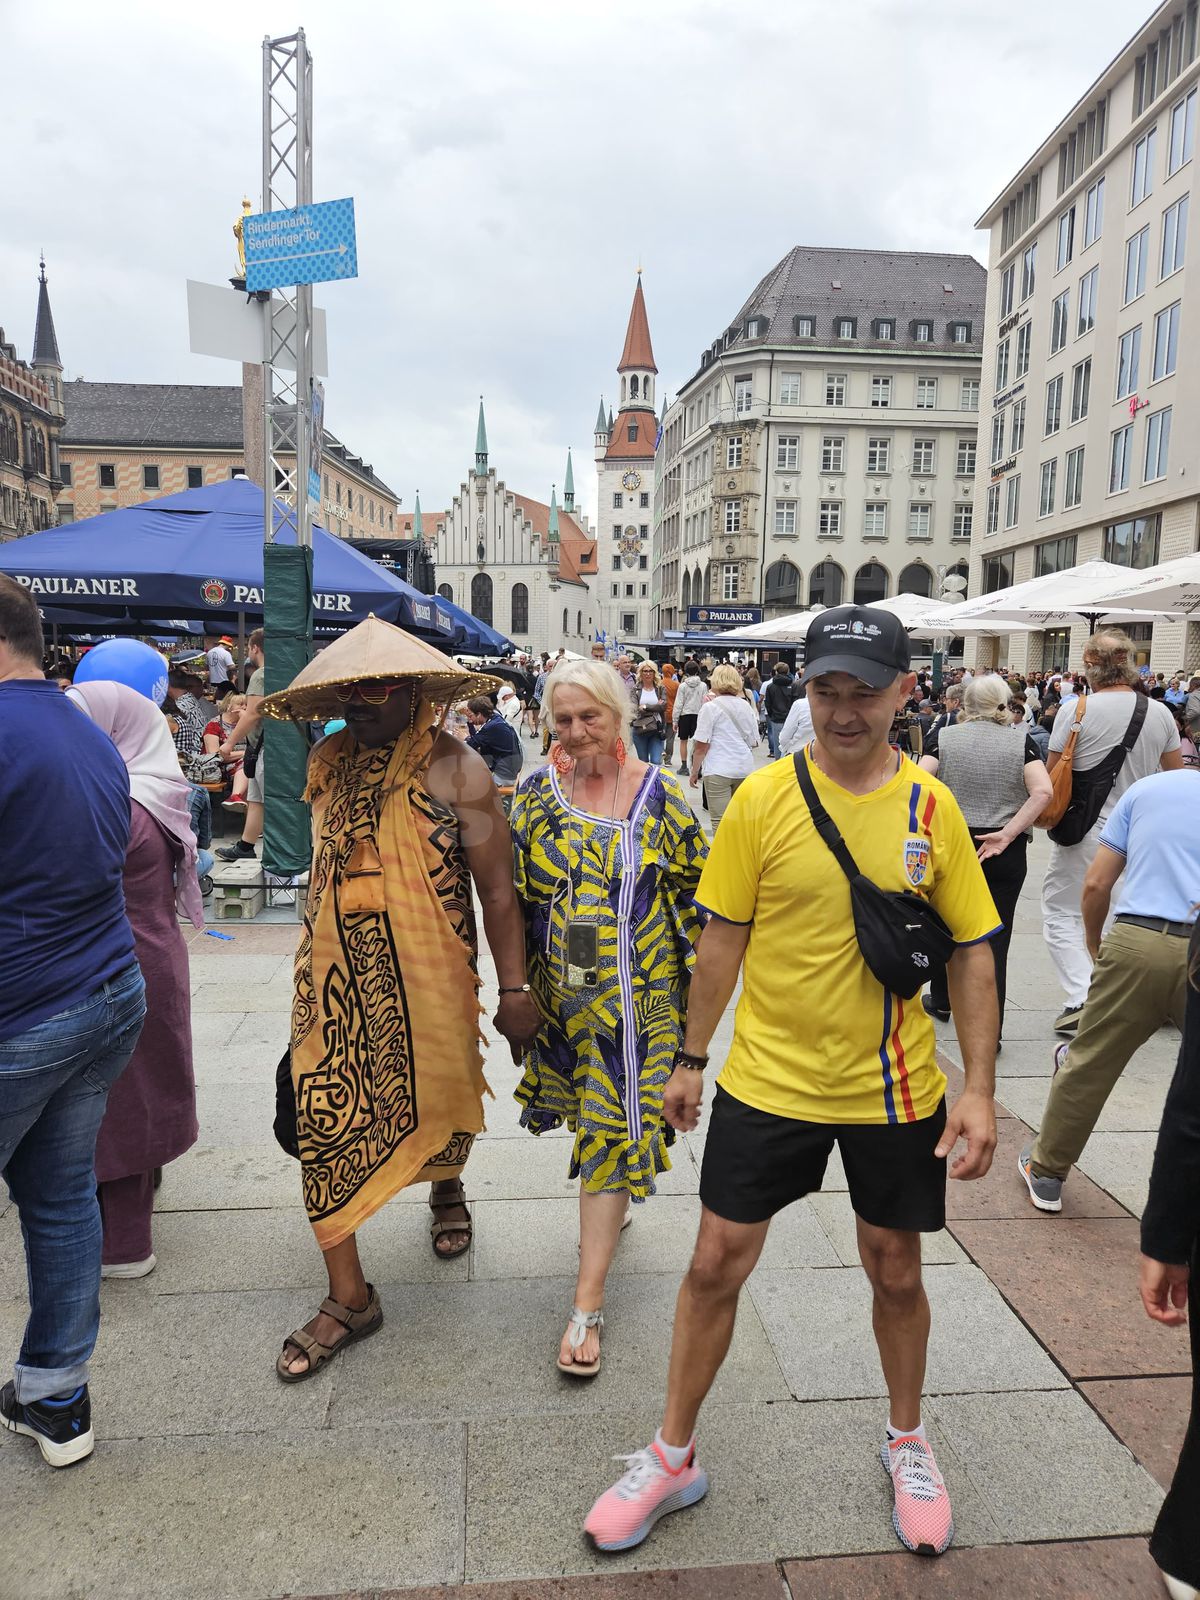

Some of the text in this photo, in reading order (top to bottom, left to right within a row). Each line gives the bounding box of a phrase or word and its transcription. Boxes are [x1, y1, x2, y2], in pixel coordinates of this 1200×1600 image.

[248, 214, 313, 234] Rindermarkt,
[248, 229, 320, 251] Sendlinger Tor
[15, 575, 140, 596] PAULANER
[233, 585, 353, 612] PANER
[709, 610, 753, 622] PAULANER
